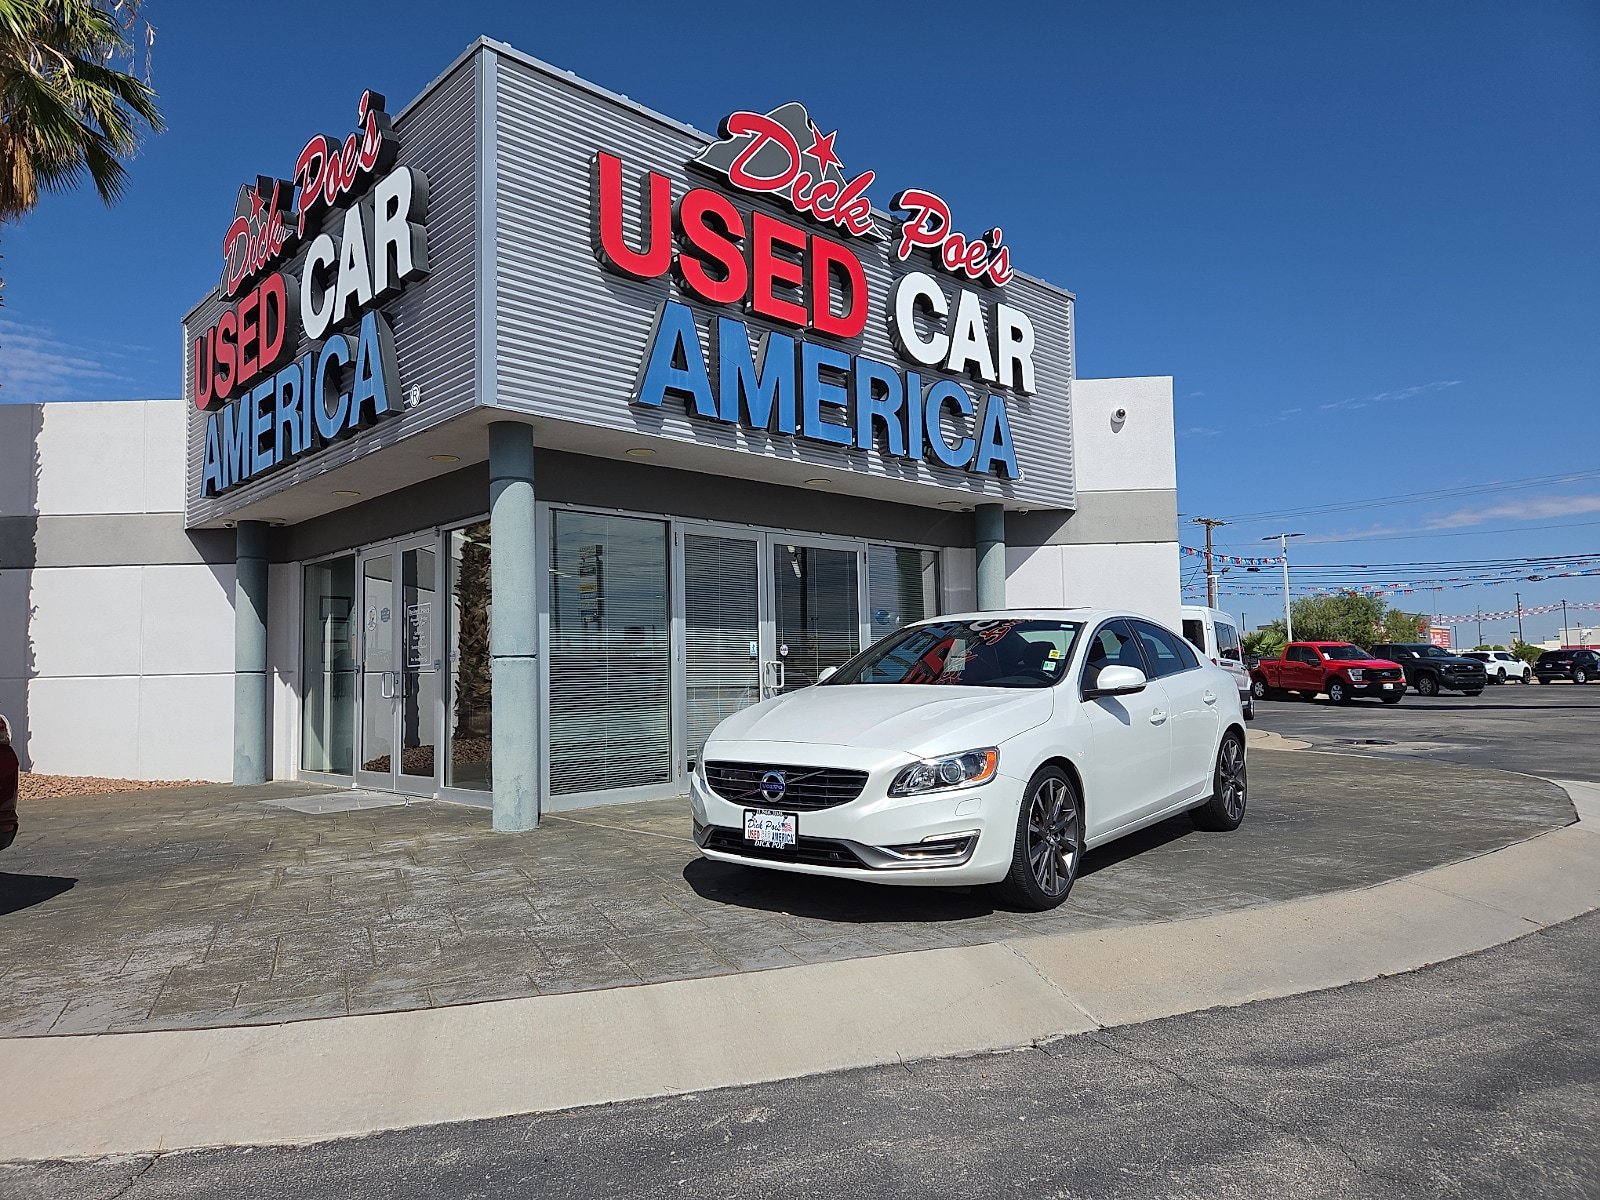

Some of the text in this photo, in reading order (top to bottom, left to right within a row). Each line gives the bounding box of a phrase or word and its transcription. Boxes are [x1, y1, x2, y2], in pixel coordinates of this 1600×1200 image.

[223, 88, 382, 297] Dick Poe's
[598, 151, 1037, 396] USED CAR
[726, 110, 1014, 288] Dick Poe's
[194, 165, 414, 411] USED CAR
[201, 310, 389, 499] AMERICA
[636, 299, 1020, 482] AMERICA
[747, 818, 763, 830] Dick
[747, 829, 761, 840] USED
[771, 832, 794, 844] AMERICA
[754, 840, 786, 850] DICK POE
